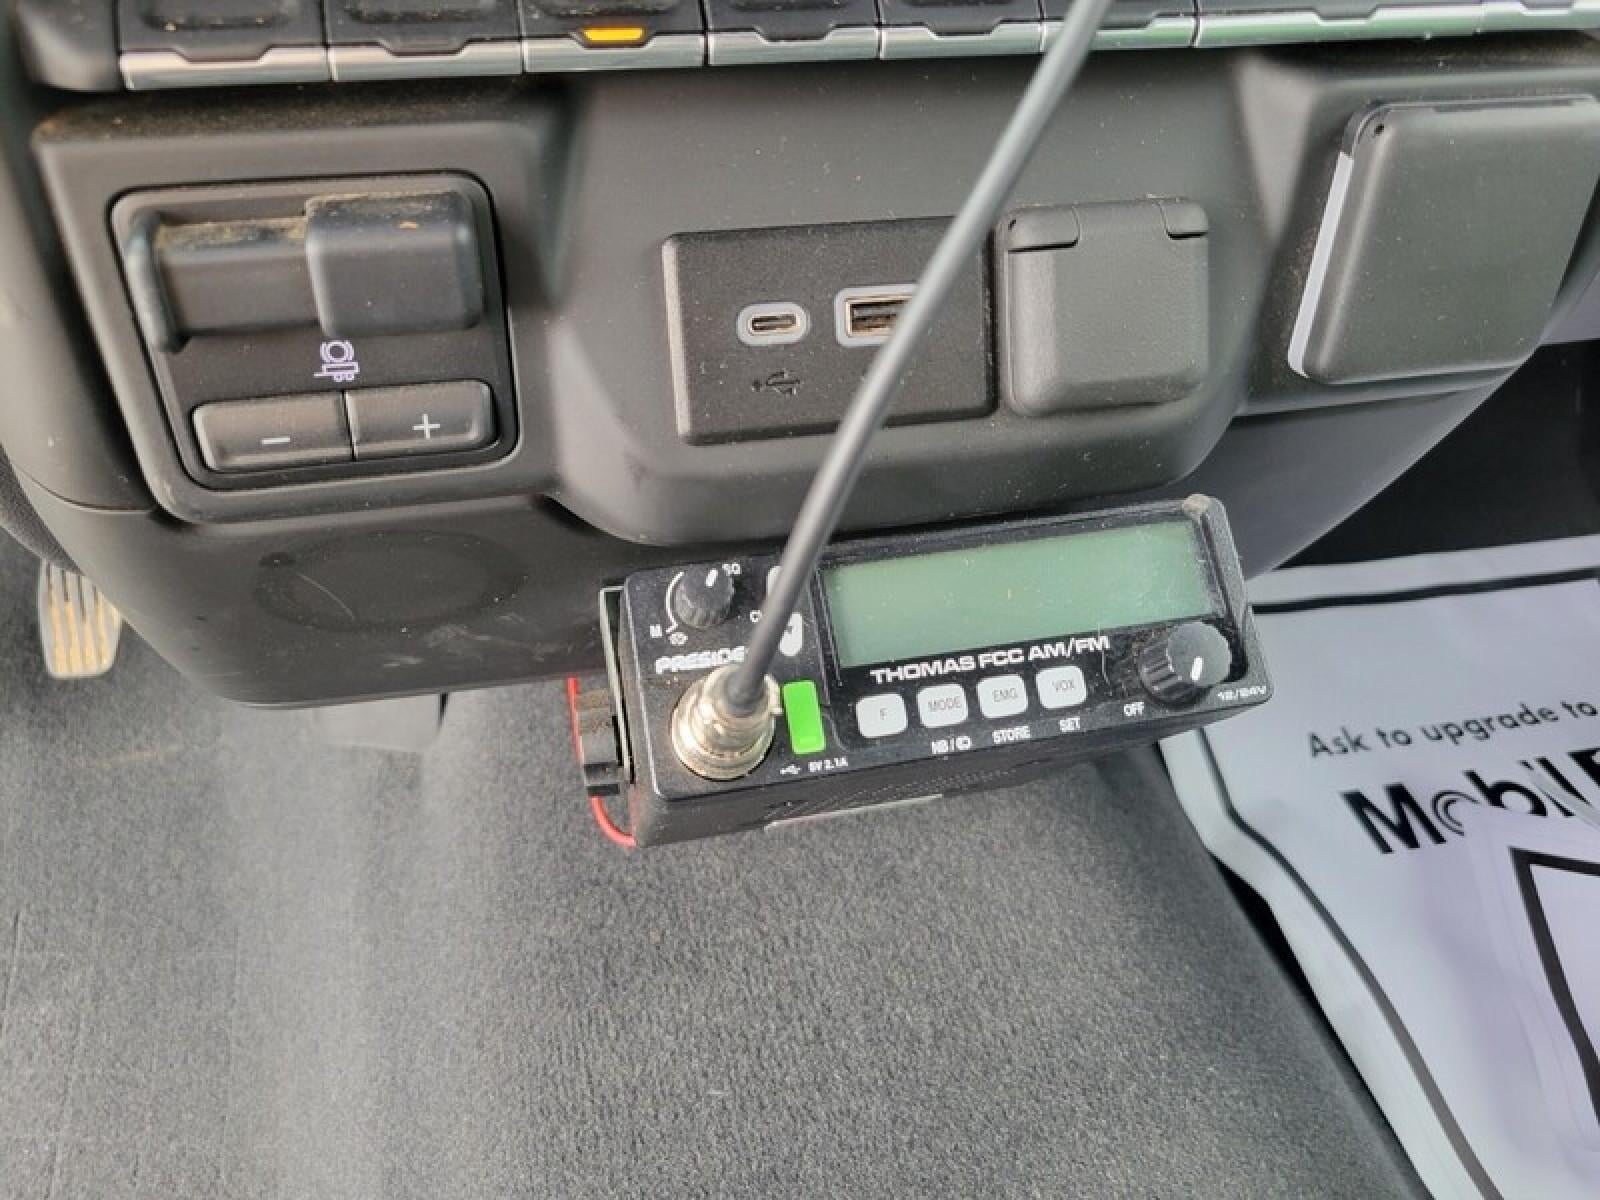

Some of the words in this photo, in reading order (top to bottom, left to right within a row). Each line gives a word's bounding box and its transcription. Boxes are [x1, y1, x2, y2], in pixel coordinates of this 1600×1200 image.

[655, 645, 746, 674] PRESIDE
[869, 655, 976, 685] THOMAS
[977, 647, 1025, 669] FCC
[1027, 635, 1111, 661] AM/FM
[1051, 679, 1075, 693] VOX
[991, 687, 1019, 703] EMG
[927, 696, 962, 712] MODE
[1123, 701, 1145, 717] OFF
[1059, 716, 1081, 733] SET
[1308, 726, 1372, 758] Ask
[1375, 726, 1413, 748] to
[1419, 702, 1559, 745] upgrade
[1560, 700, 1600, 718] to
[991, 725, 1031, 744] STORE
